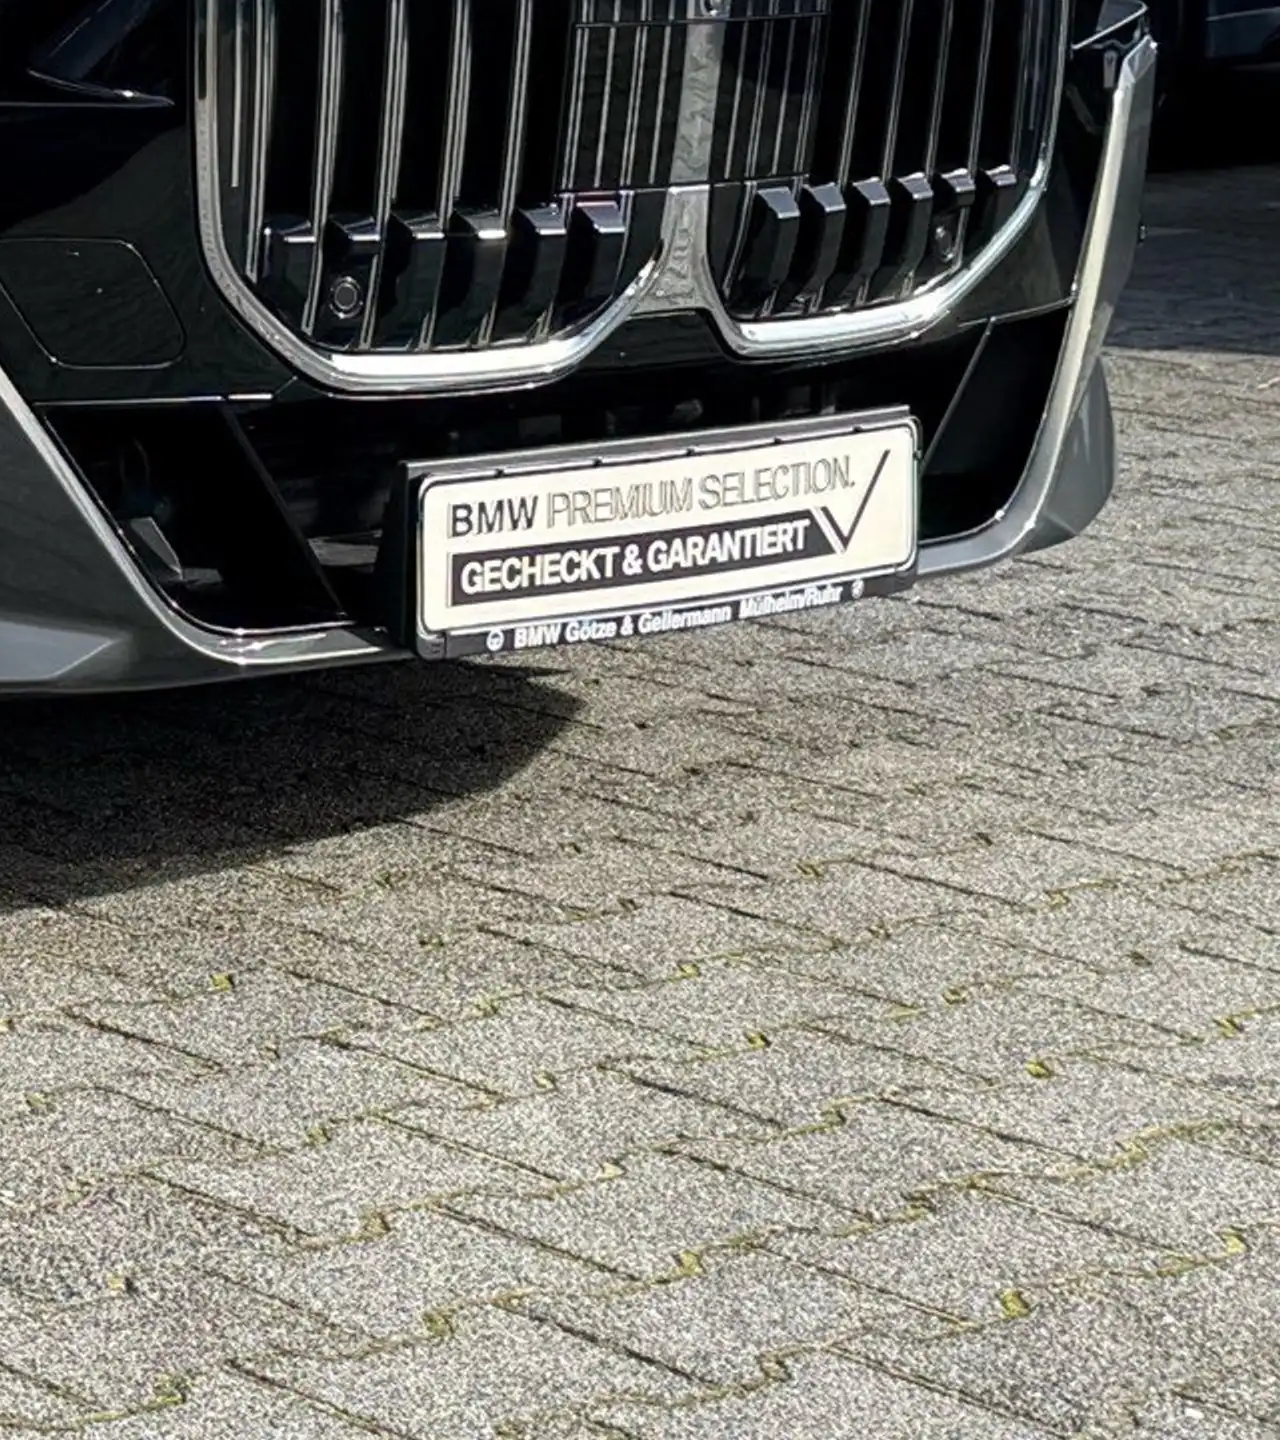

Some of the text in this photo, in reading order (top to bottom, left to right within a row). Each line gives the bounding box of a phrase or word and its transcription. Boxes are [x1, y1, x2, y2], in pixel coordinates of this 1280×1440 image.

[449, 495, 539, 538] BMW
[546, 477, 693, 528] PREMIUM
[460, 518, 811, 595] GECHECKT & GARANTIERT
[513, 623, 561, 649] BMW
[565, 619, 617, 643] Götze
[620, 614, 634, 636] &
[638, 605, 732, 634] Gellermann
